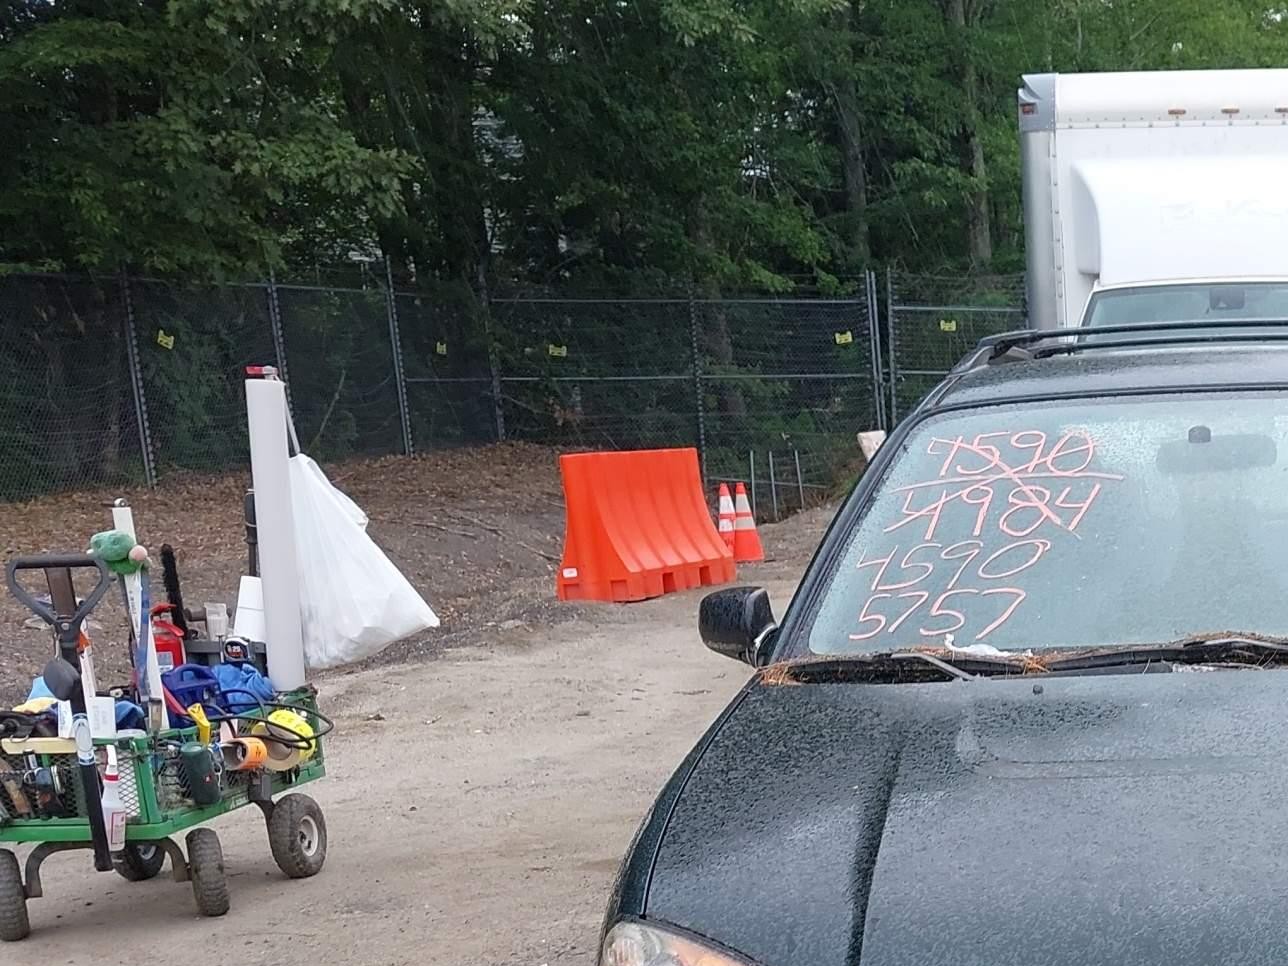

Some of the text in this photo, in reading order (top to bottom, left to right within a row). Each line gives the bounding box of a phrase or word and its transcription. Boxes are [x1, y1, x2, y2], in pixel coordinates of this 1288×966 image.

[928, 430, 1095, 477] 4590
[902, 483, 1102, 541] 4984
[856, 538, 1051, 592] 4590
[848, 587, 1027, 640] 5757
